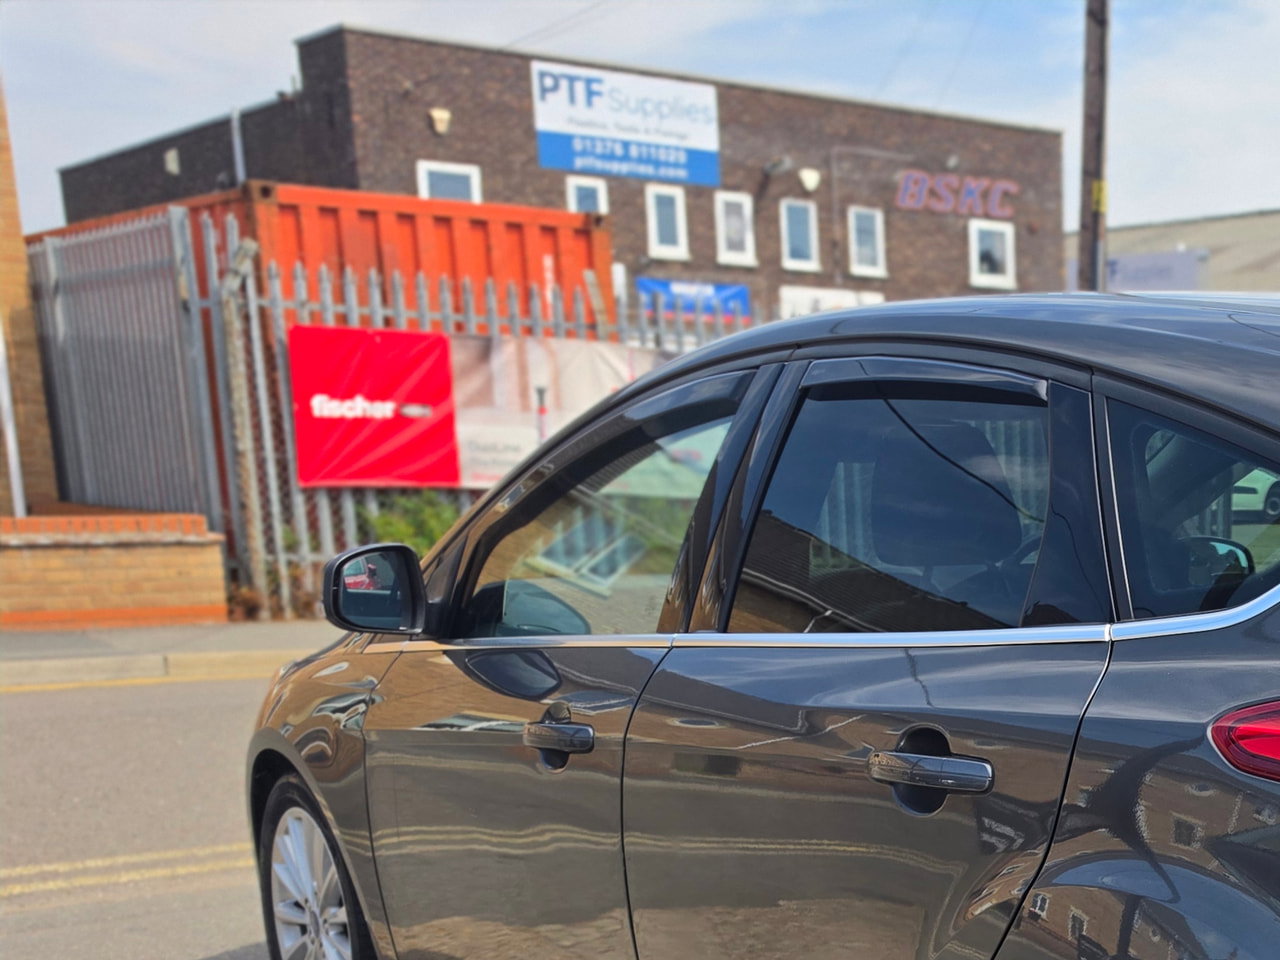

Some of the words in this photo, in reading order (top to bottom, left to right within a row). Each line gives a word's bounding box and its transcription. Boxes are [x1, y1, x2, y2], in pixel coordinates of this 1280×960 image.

[538, 70, 604, 108] PTF
[607, 88, 714, 125] Supplies
[896, 168, 1020, 217] BSKC
[310, 393, 396, 419] fischer
